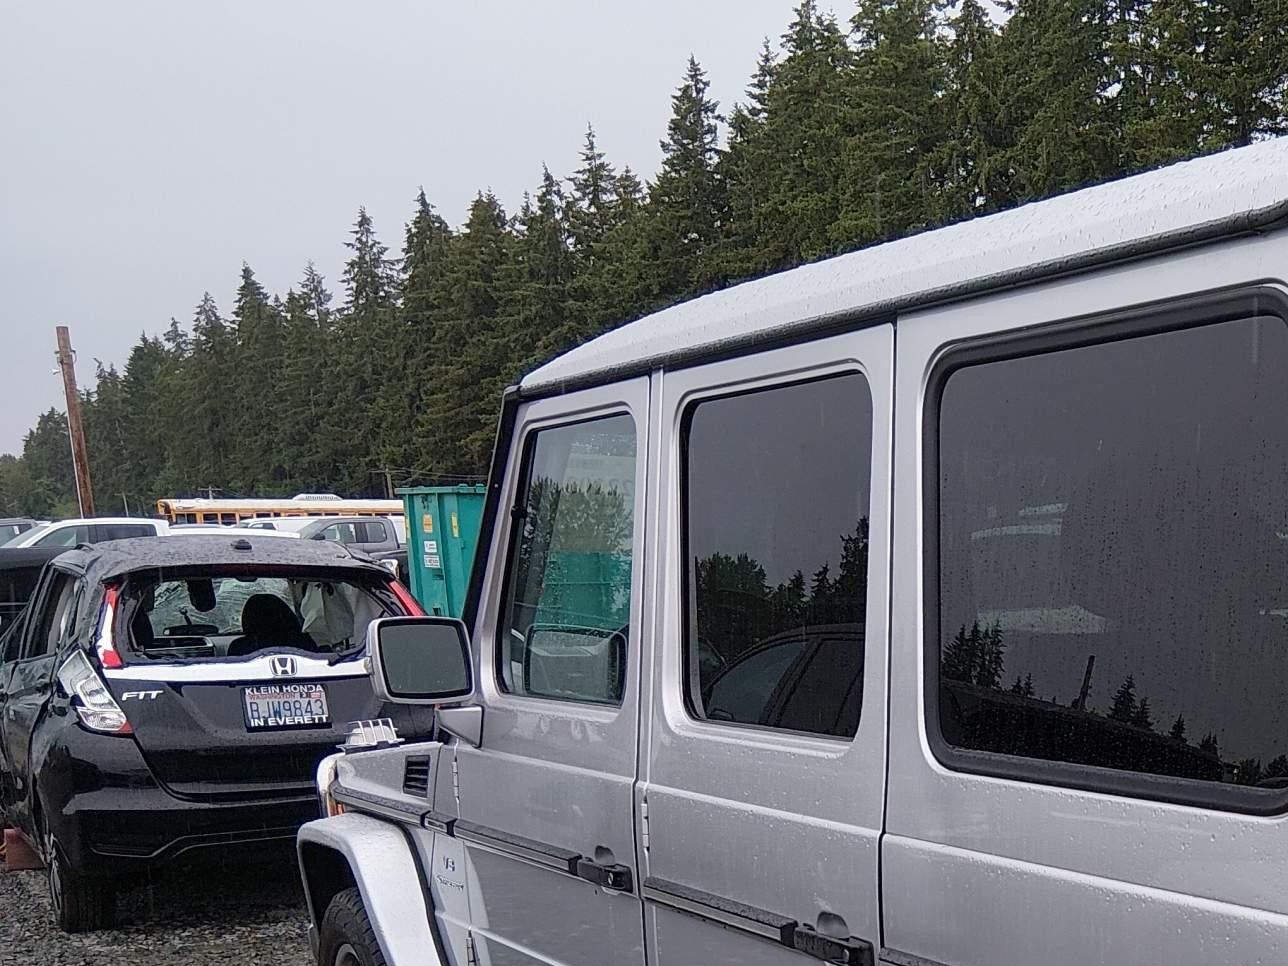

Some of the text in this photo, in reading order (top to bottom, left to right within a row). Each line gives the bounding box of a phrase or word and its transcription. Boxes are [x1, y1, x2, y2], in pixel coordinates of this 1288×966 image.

[121, 690, 164, 701] FIT
[245, 684, 324, 695] KLEIN HONDA
[249, 699, 325, 719] BJW9843
[250, 714, 329, 727] IN EVERETT
